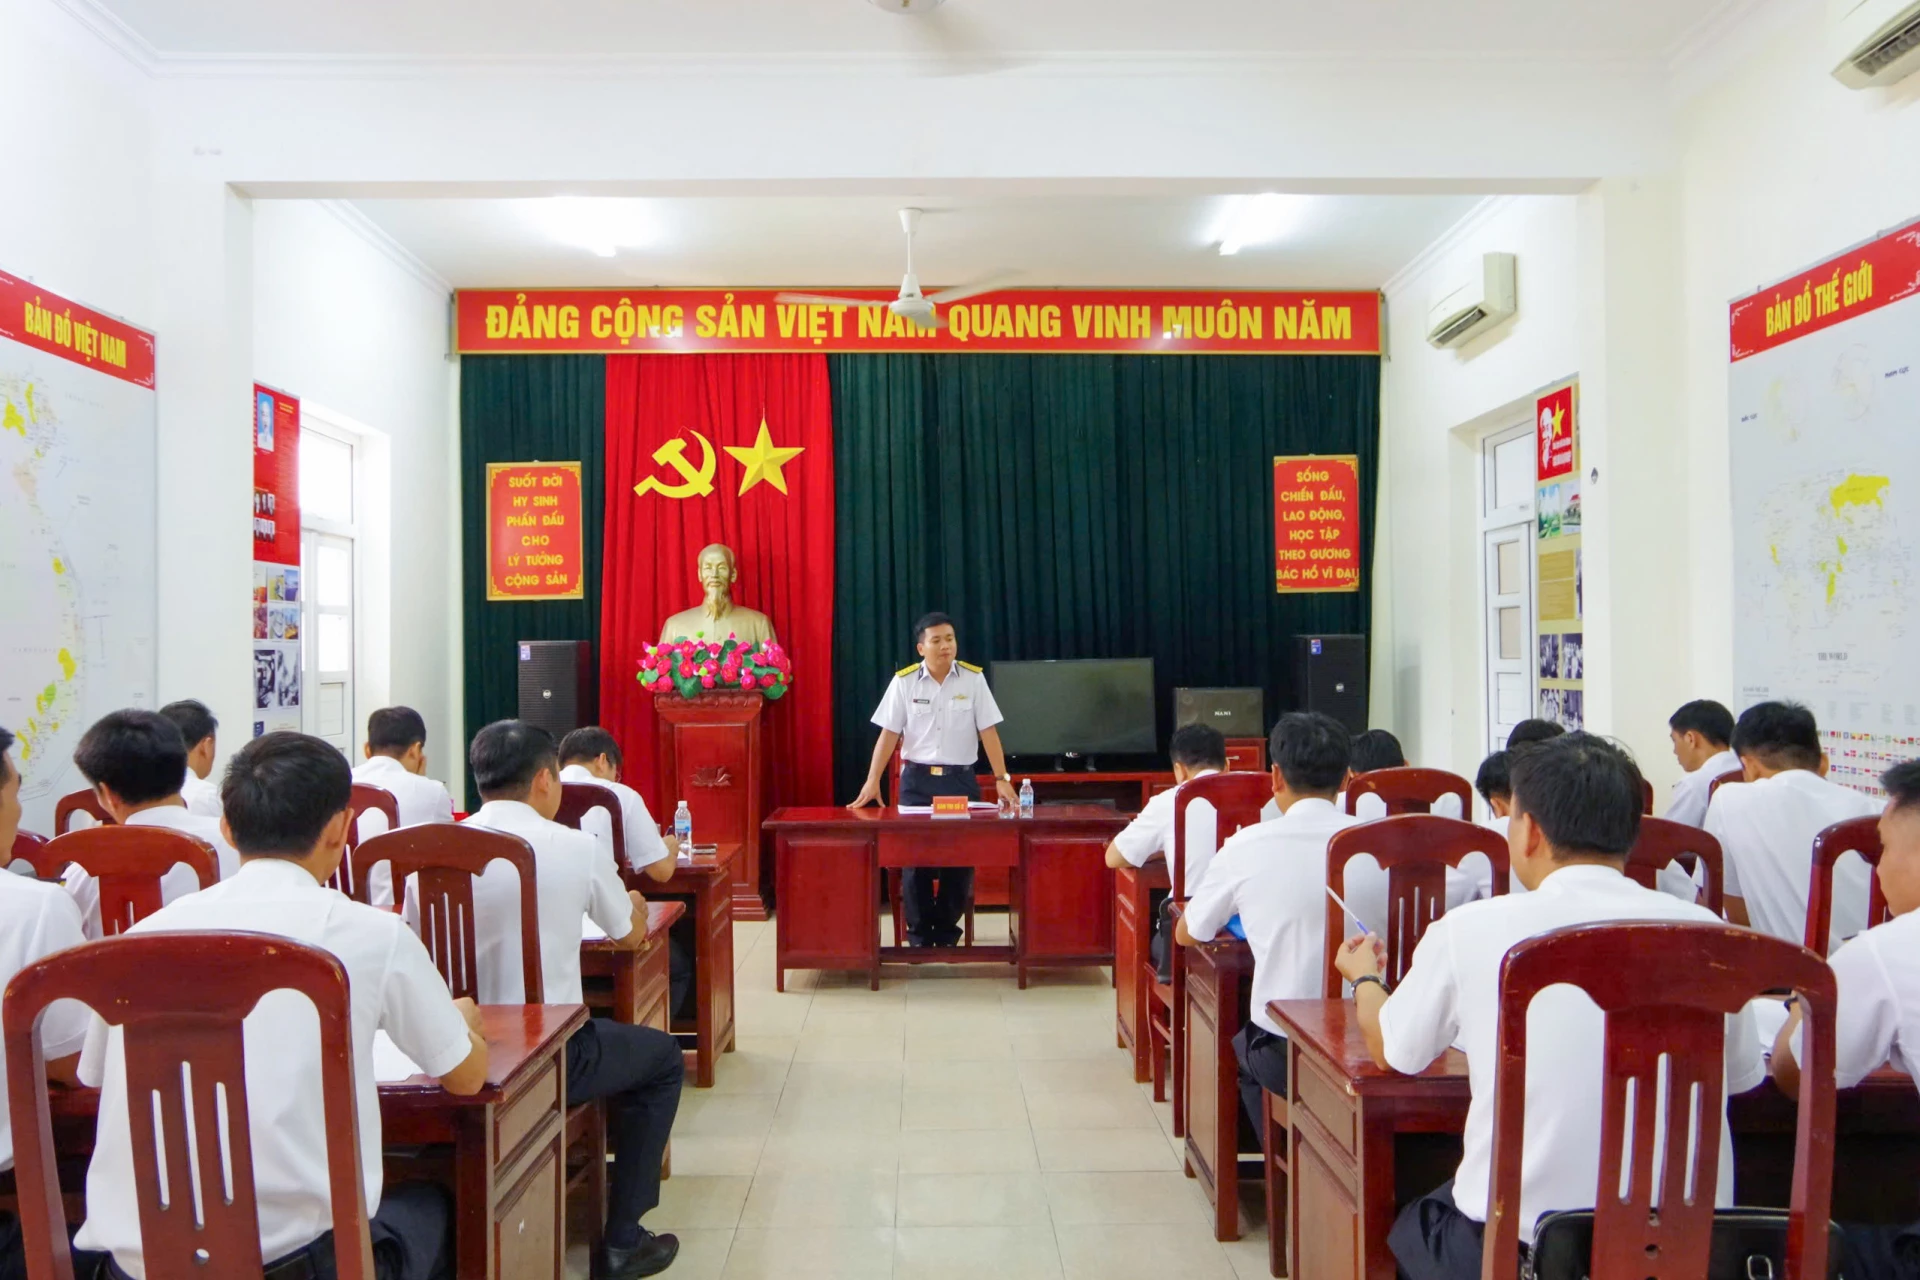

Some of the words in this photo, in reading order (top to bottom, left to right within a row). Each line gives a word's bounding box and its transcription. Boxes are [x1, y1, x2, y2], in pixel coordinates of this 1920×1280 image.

[1766, 293, 1792, 337] BẢN
[1794, 280, 1812, 326] ĐỒ
[1814, 268, 1840, 318] THẾ
[1844, 260, 1872, 307] GIỚI
[485, 292, 580, 339] ĐẢNG
[590, 298, 684, 345] CỘNG
[696, 292, 766, 338] SẢN
[776, 298, 848, 345] VIỆT
[858, 304, 936, 338] NAM
[948, 304, 1062, 342] QUANG
[1072, 305, 1151, 340] VINH
[1162, 298, 1264, 340] MUÔN
[1274, 298, 1352, 340] NĂM
[24, 295, 52, 341] BẢN
[54, 308, 72, 348] ĐỒ
[74, 320, 98, 362] VIỆT
[100, 332, 126, 369] NAM
[508, 472, 538, 488] SUỐT
[542, 472, 563, 486] ĐỜI
[1296, 465, 1330, 482] SỐNG
[513, 496, 528, 507] HY
[533, 495, 558, 506] SINH
[1280, 486, 1314, 502] CHIẾN
[1320, 485, 1346, 502] ĐẤU,
[506, 511, 536, 527] PHẤN
[542, 510, 564, 526] ĐẤU
[1283, 510, 1305, 521] LAO
[1309, 507, 1346, 524] ĐỘNG,
[522, 535, 550, 546] CHO
[1289, 530, 1314, 544] HỌC
[1320, 526, 1340, 542] TẬP
[508, 553, 520, 566] LÝ
[526, 551, 564, 566] TƯỞNG
[1278, 549, 1306, 560] THEO
[1310, 548, 1351, 560] GƯƠNG
[504, 573, 540, 588] CỘNG
[546, 570, 568, 585] SẢN
[1276, 565, 1299, 580] BÁC
[1322, 566, 1333, 578] VĨ
[1336, 568, 1356, 581] ĐẠI
